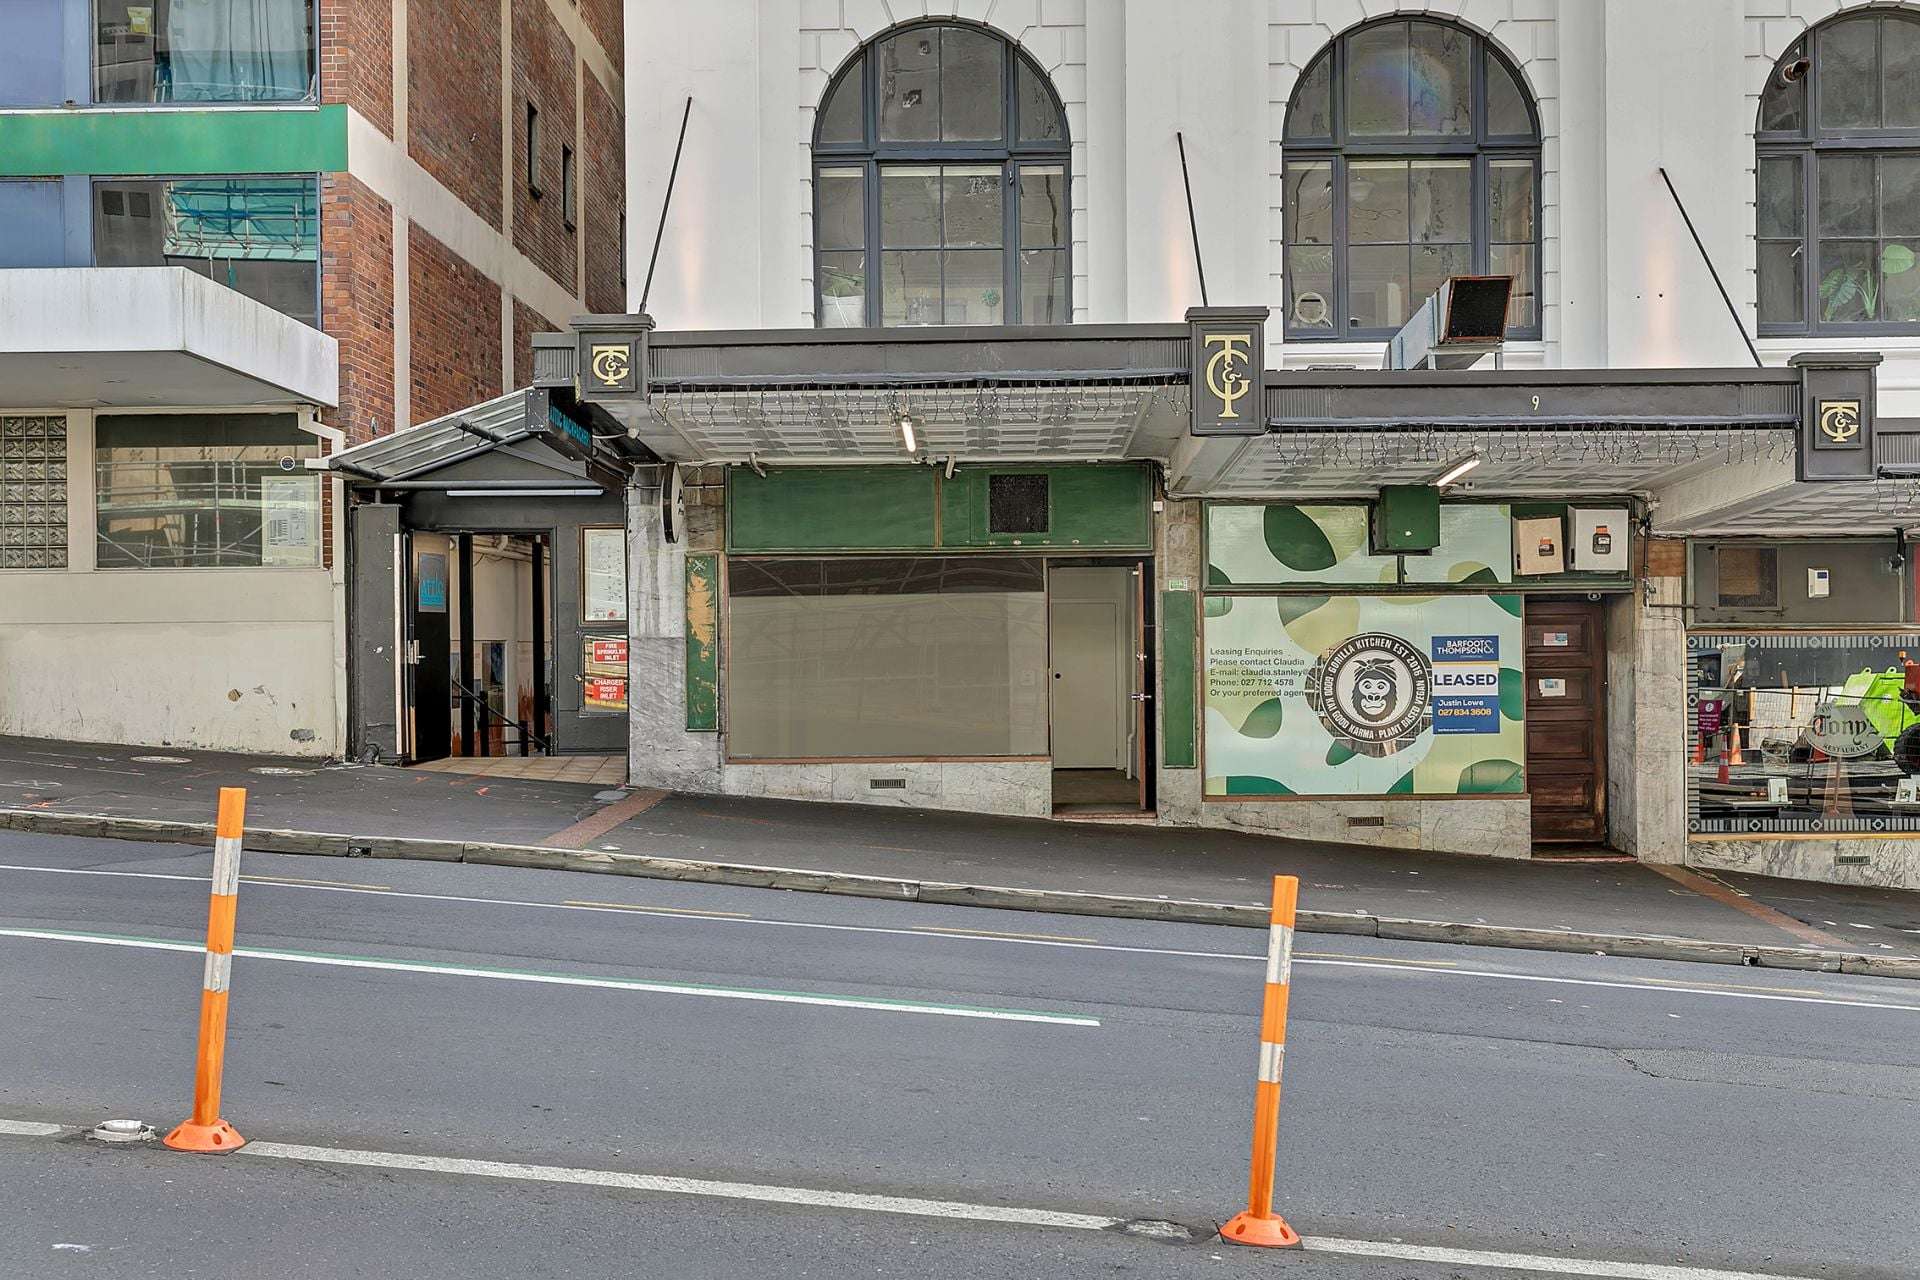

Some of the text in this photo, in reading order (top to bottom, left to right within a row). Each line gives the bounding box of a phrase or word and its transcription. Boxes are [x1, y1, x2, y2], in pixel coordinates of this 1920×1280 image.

[1531, 395, 1540, 411] 9
[1446, 640, 1484, 648] BARFOOT
[1210, 648, 1283, 656] Leasing Enquiries
[1437, 647, 1484, 655] THOMPSON
[1329, 637, 1423, 676] GORILLA KITCHEN EST 2016
[1273, 658, 1305, 666] Claudia
[1434, 674, 1497, 686] LEASED
[1243, 689, 1282, 698] preferred
[1438, 699, 1462, 707] Justin
[1323, 676, 1375, 740] GOOD KAI GOOD KARMA
[1378, 680, 1426, 739] PLANT BASED VEGAN
[1438, 708, 1453, 716] 027
